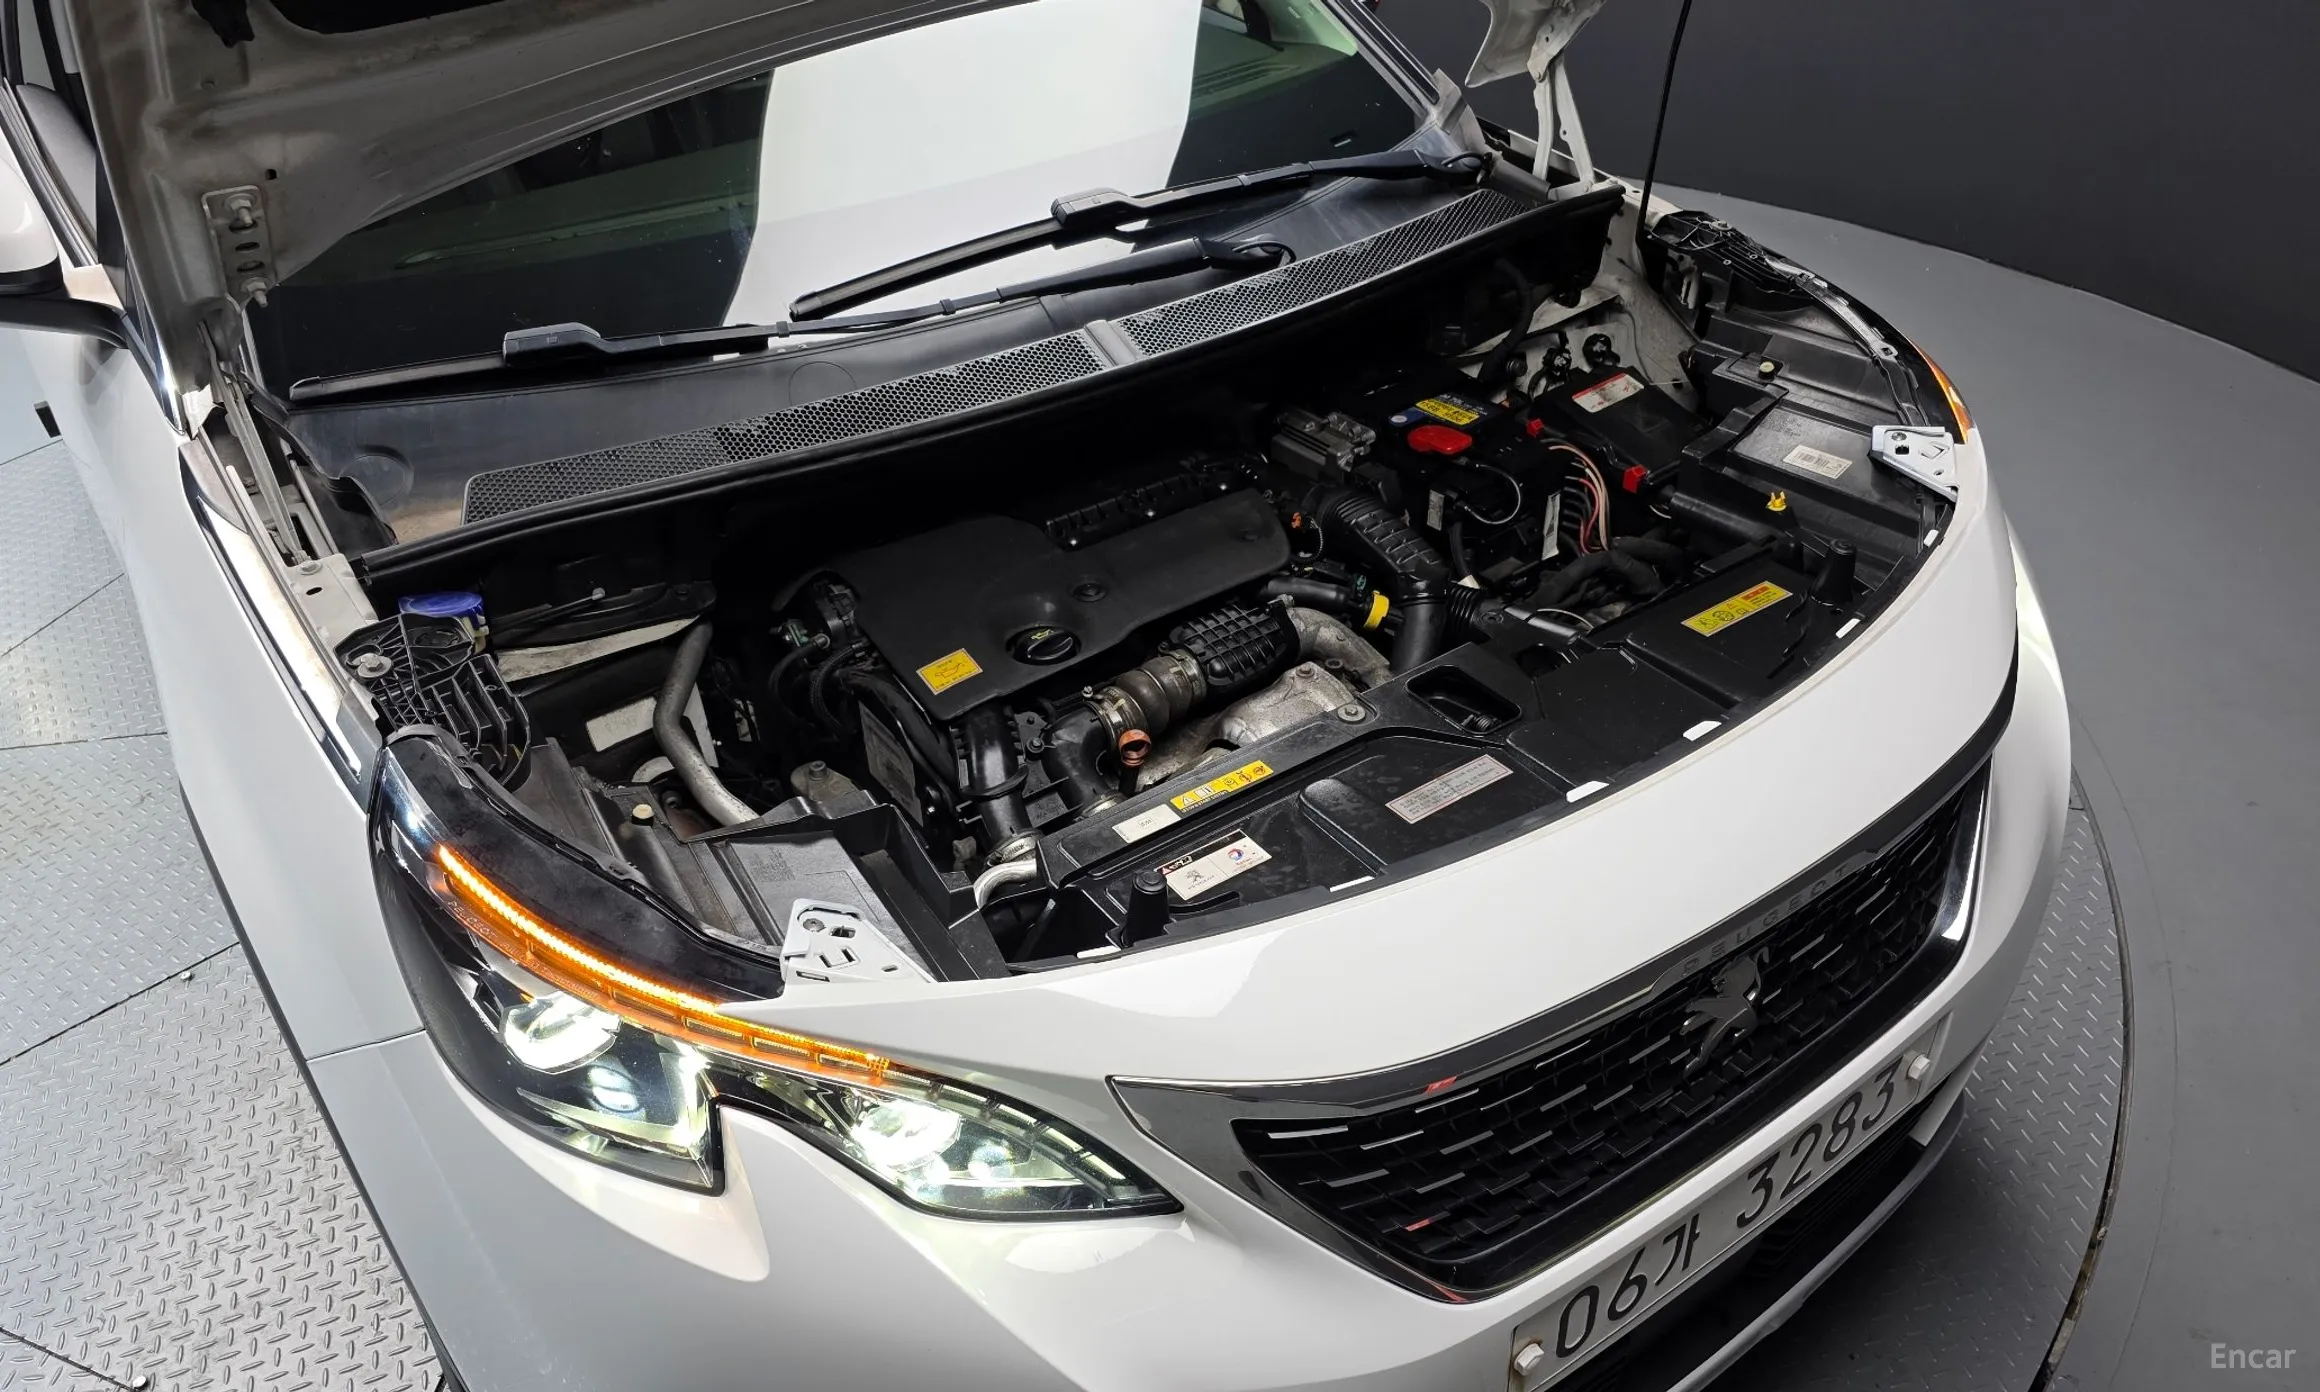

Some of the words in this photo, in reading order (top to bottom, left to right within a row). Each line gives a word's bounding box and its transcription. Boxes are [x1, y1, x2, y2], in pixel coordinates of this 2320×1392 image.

[447, 900, 498, 939] PEUGEOT
[1682, 864, 1847, 976] PEUGEOT
[1555, 1213, 1701, 1359] 06가
[1736, 1062, 1900, 1230] 3283
